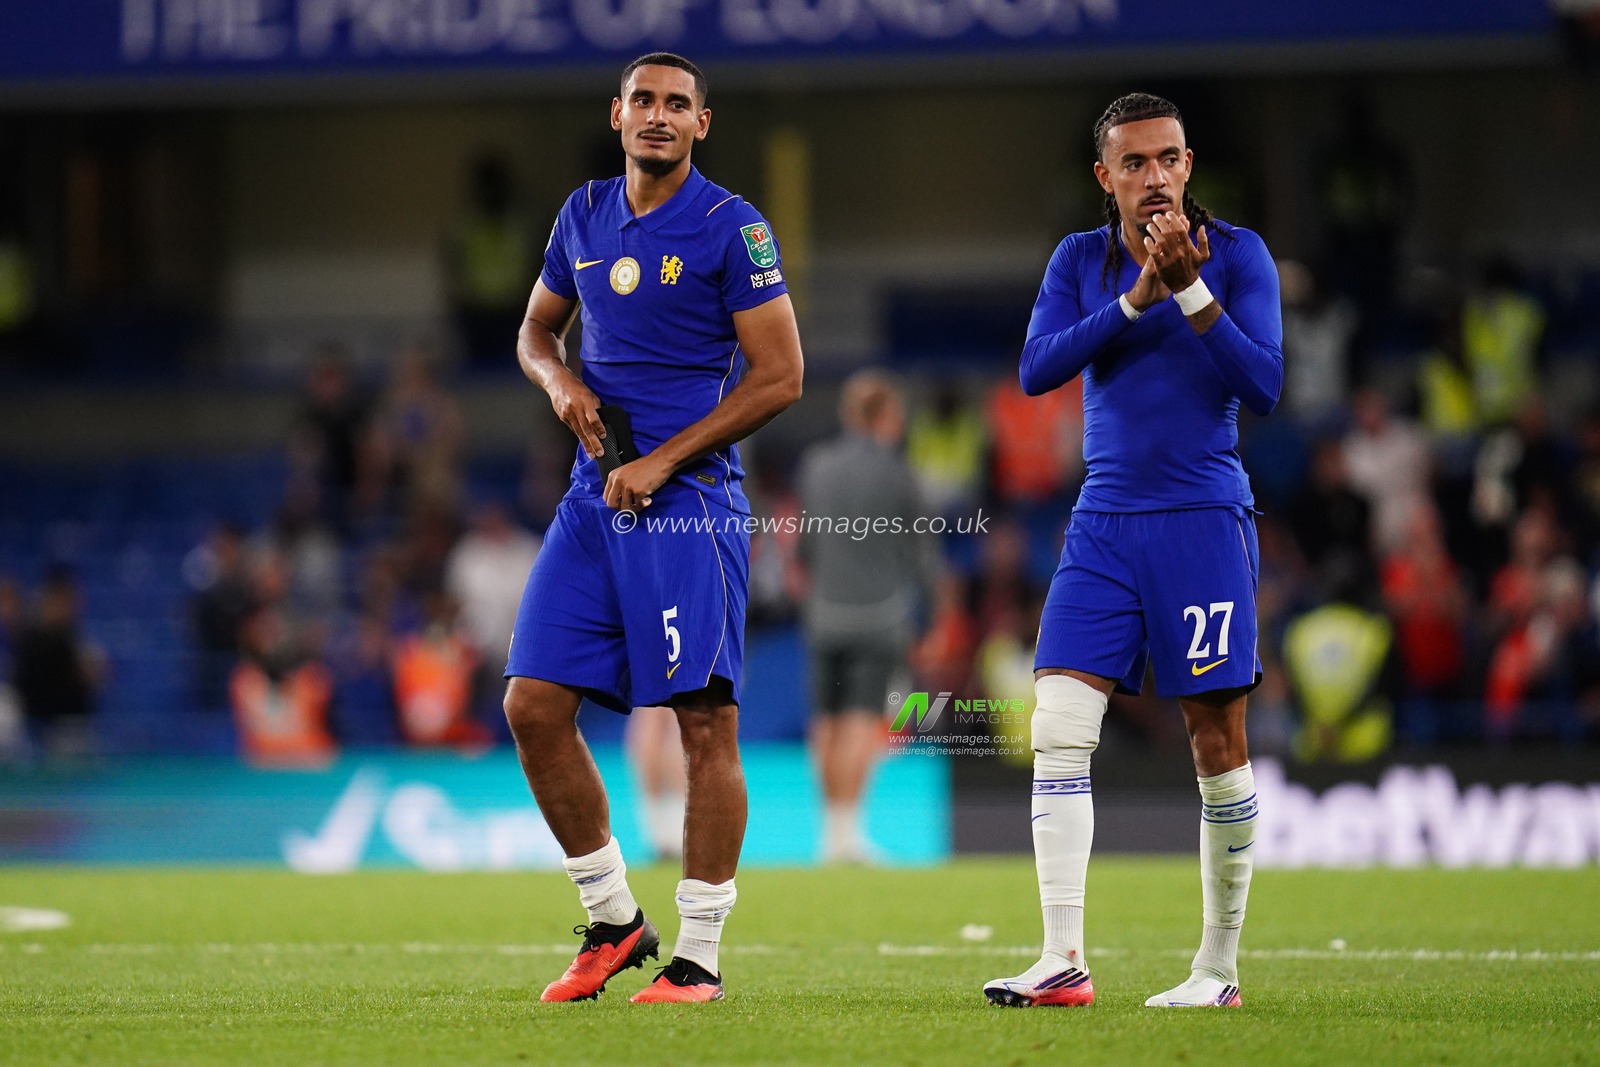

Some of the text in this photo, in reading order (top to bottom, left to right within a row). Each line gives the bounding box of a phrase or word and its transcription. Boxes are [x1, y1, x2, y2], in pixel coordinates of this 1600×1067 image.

[750, 273, 763, 283] No
[662, 605, 681, 663] 5
[1183, 601, 1234, 659] 27
